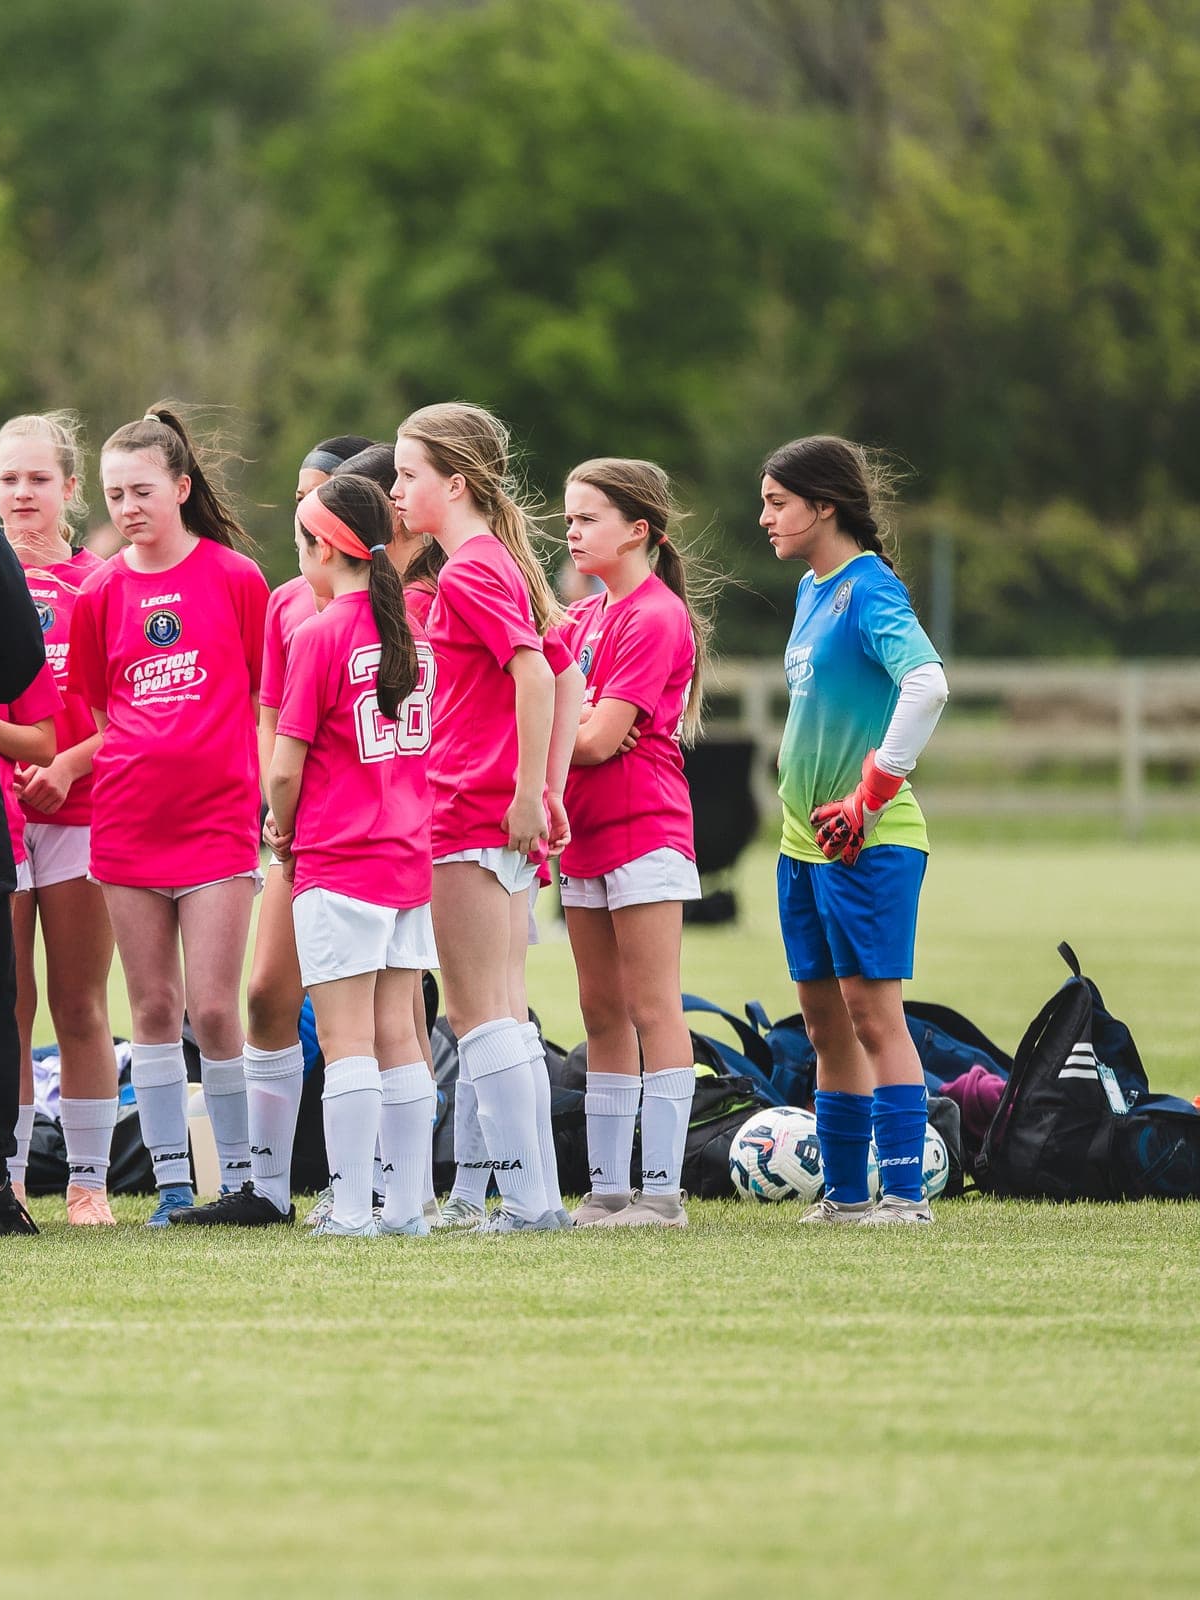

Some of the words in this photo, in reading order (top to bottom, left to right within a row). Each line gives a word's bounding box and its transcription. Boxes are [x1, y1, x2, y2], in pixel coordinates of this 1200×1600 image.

[140, 592, 182, 608] LEGEA
[133, 649, 199, 682] ACTION
[133, 666, 196, 698] SPORTS
[347, 640, 438, 764] 28
